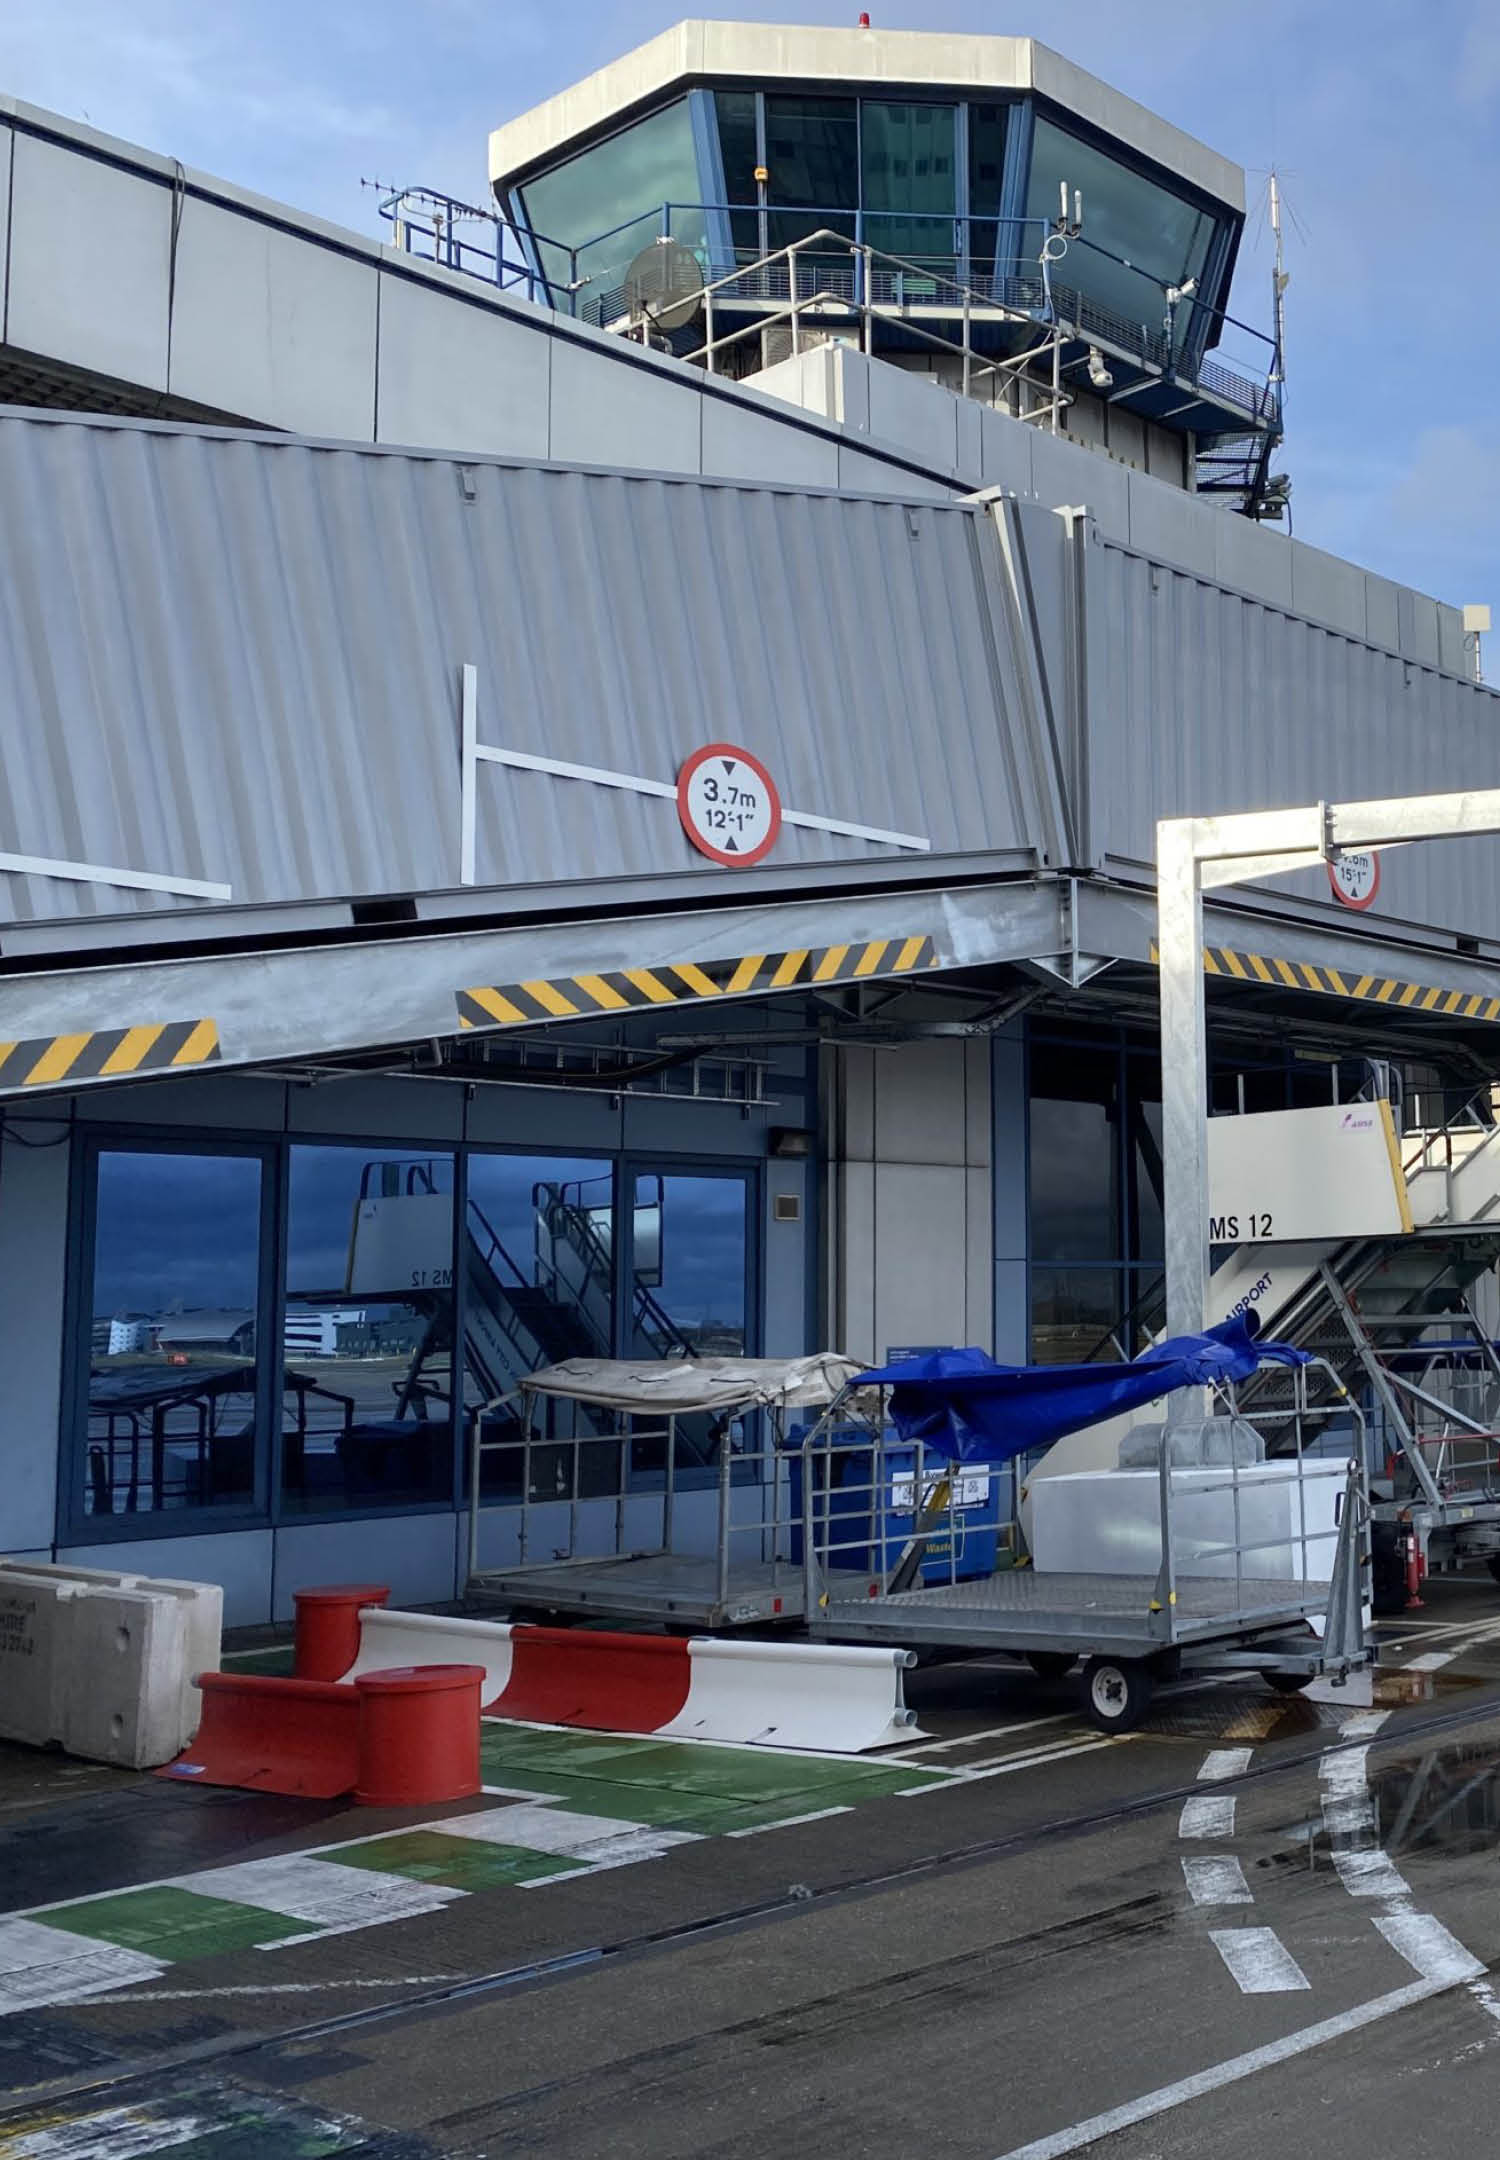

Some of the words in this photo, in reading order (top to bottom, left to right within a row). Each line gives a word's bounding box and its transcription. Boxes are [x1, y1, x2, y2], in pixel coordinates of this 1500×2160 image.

[703, 777, 756, 809] 3.7m
[1209, 1216, 1239, 1241] MS
[1248, 1213, 1273, 1238] 12
